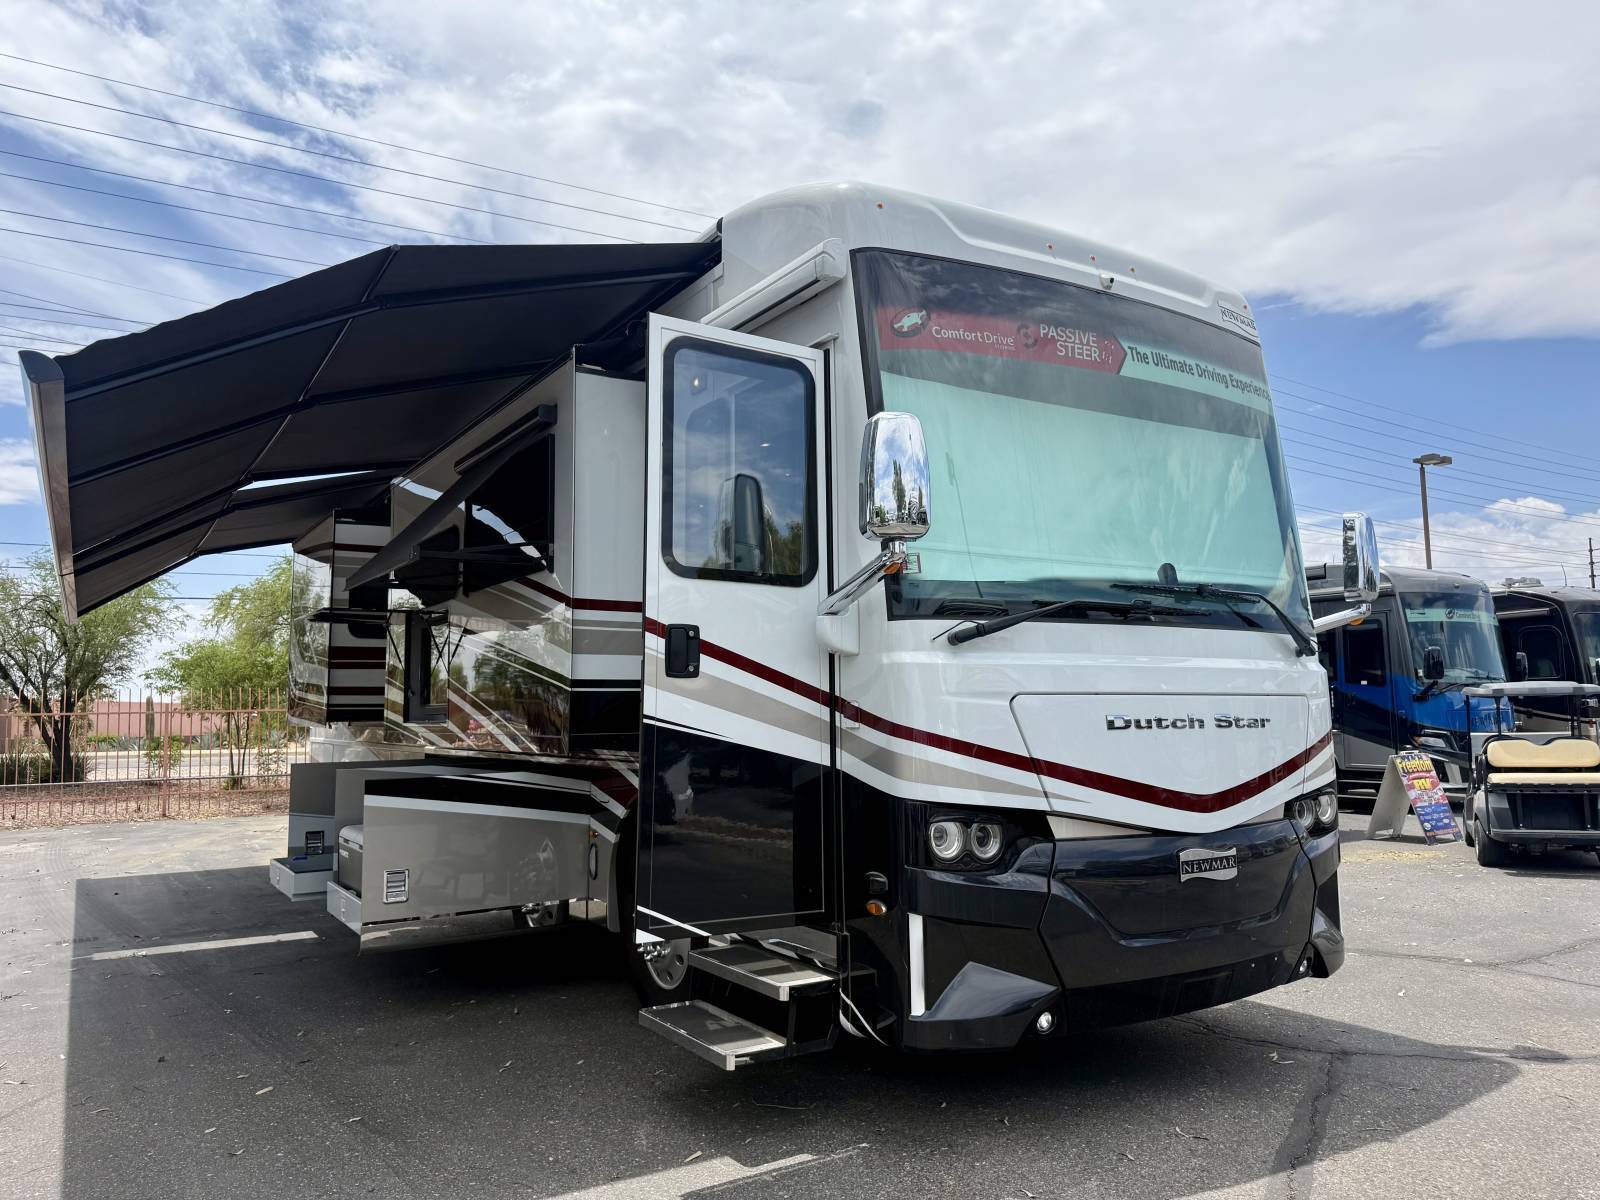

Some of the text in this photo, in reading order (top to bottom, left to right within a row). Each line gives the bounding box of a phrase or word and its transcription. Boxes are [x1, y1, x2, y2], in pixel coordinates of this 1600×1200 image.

[932, 326, 1016, 346] Comfort Drive
[1040, 323, 1098, 347] PASSIVE
[1056, 341, 1101, 363] STEER
[1127, 345, 1150, 365] The
[1150, 350, 1195, 376] Ultimate
[1195, 363, 1229, 389] Driving
[1105, 713, 1271, 731] Dutch Star
[1182, 856, 1237, 874] NEWMAR
